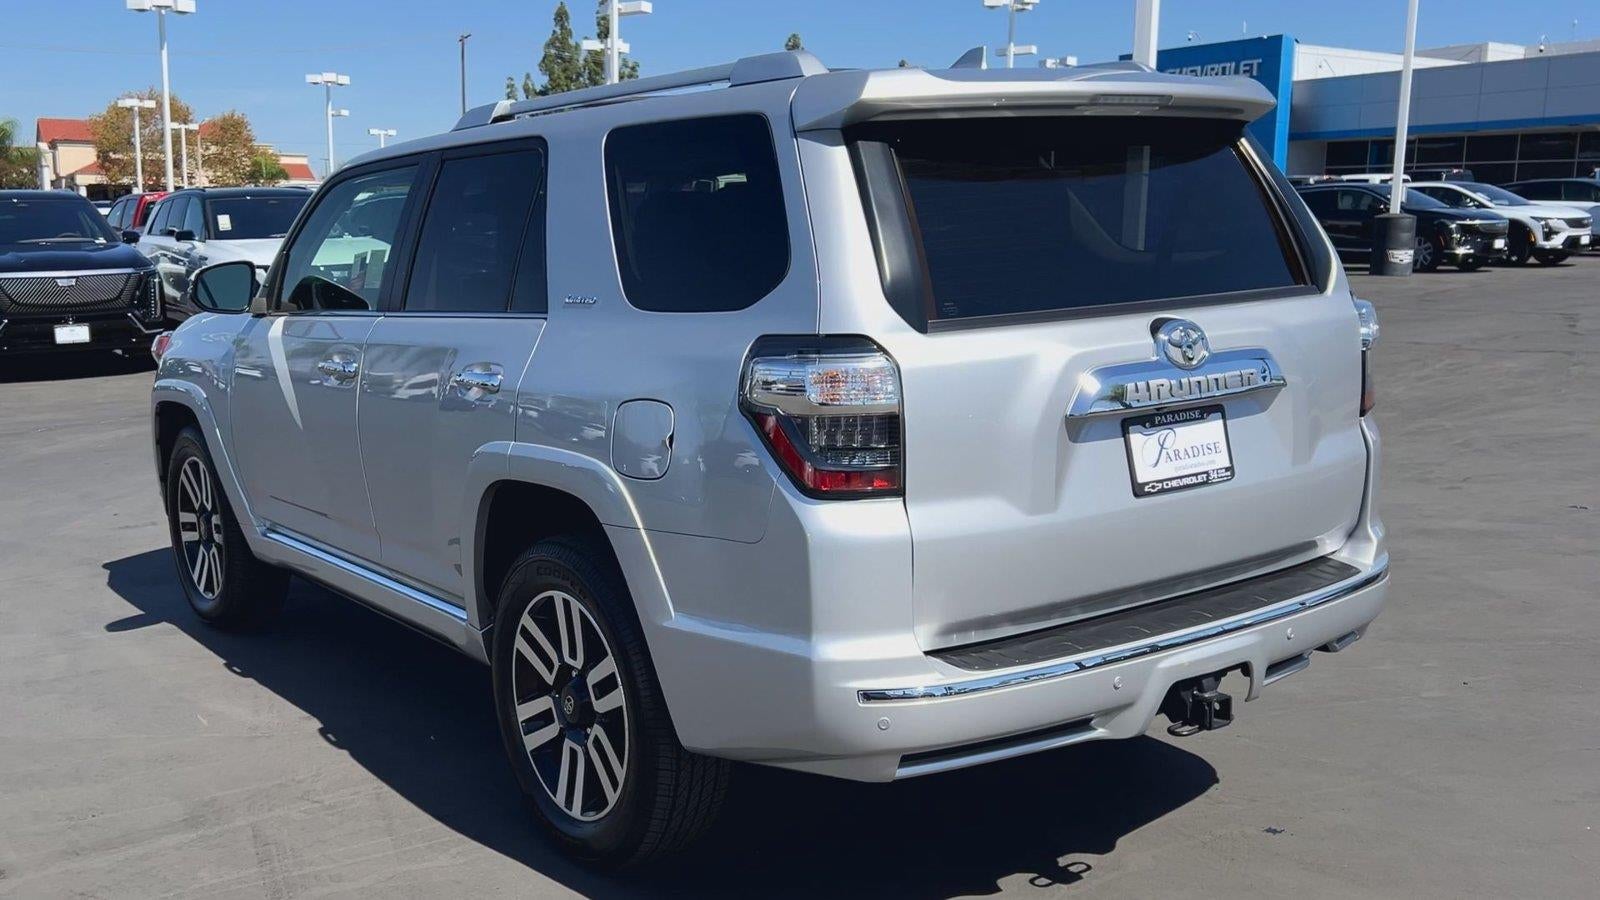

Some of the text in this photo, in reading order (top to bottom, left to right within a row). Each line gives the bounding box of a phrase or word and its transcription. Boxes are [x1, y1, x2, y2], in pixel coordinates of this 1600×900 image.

[1125, 369, 1257, 402] 4RUNNER
[1155, 410, 1202, 425] PARADISE
[1163, 474, 1208, 489] CHEVROLET
